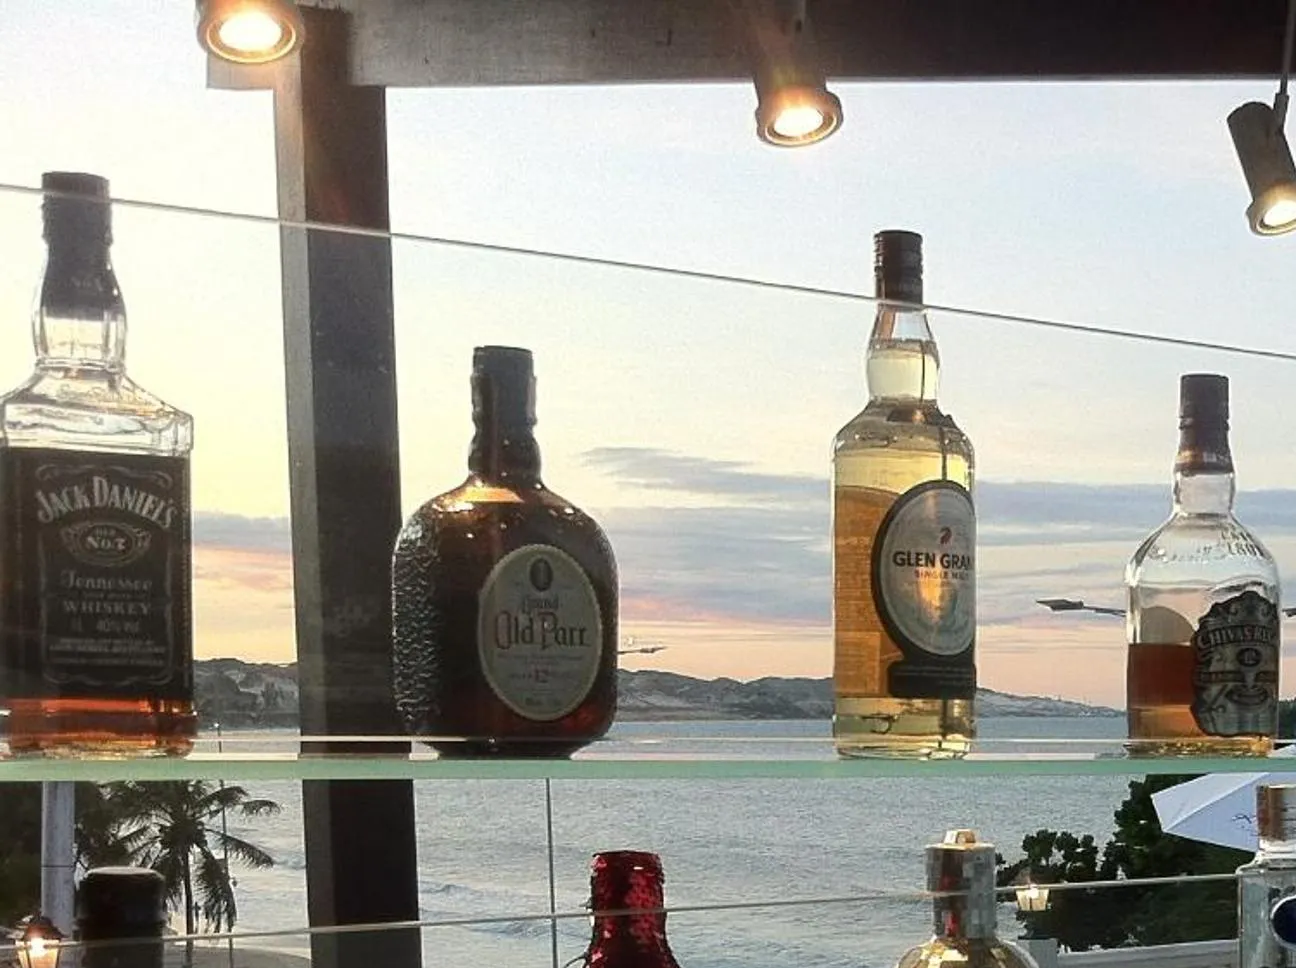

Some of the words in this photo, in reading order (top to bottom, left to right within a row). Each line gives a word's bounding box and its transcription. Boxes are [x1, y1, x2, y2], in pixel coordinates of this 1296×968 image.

[36, 484, 91, 524] JACK
[92, 475, 177, 529] DANIEL'S
[892, 550, 936, 568] GLEN
[494, 610, 535, 650] Old
[537, 611, 593, 651] Parr
[1196, 625, 1254, 649] CHIVAS
